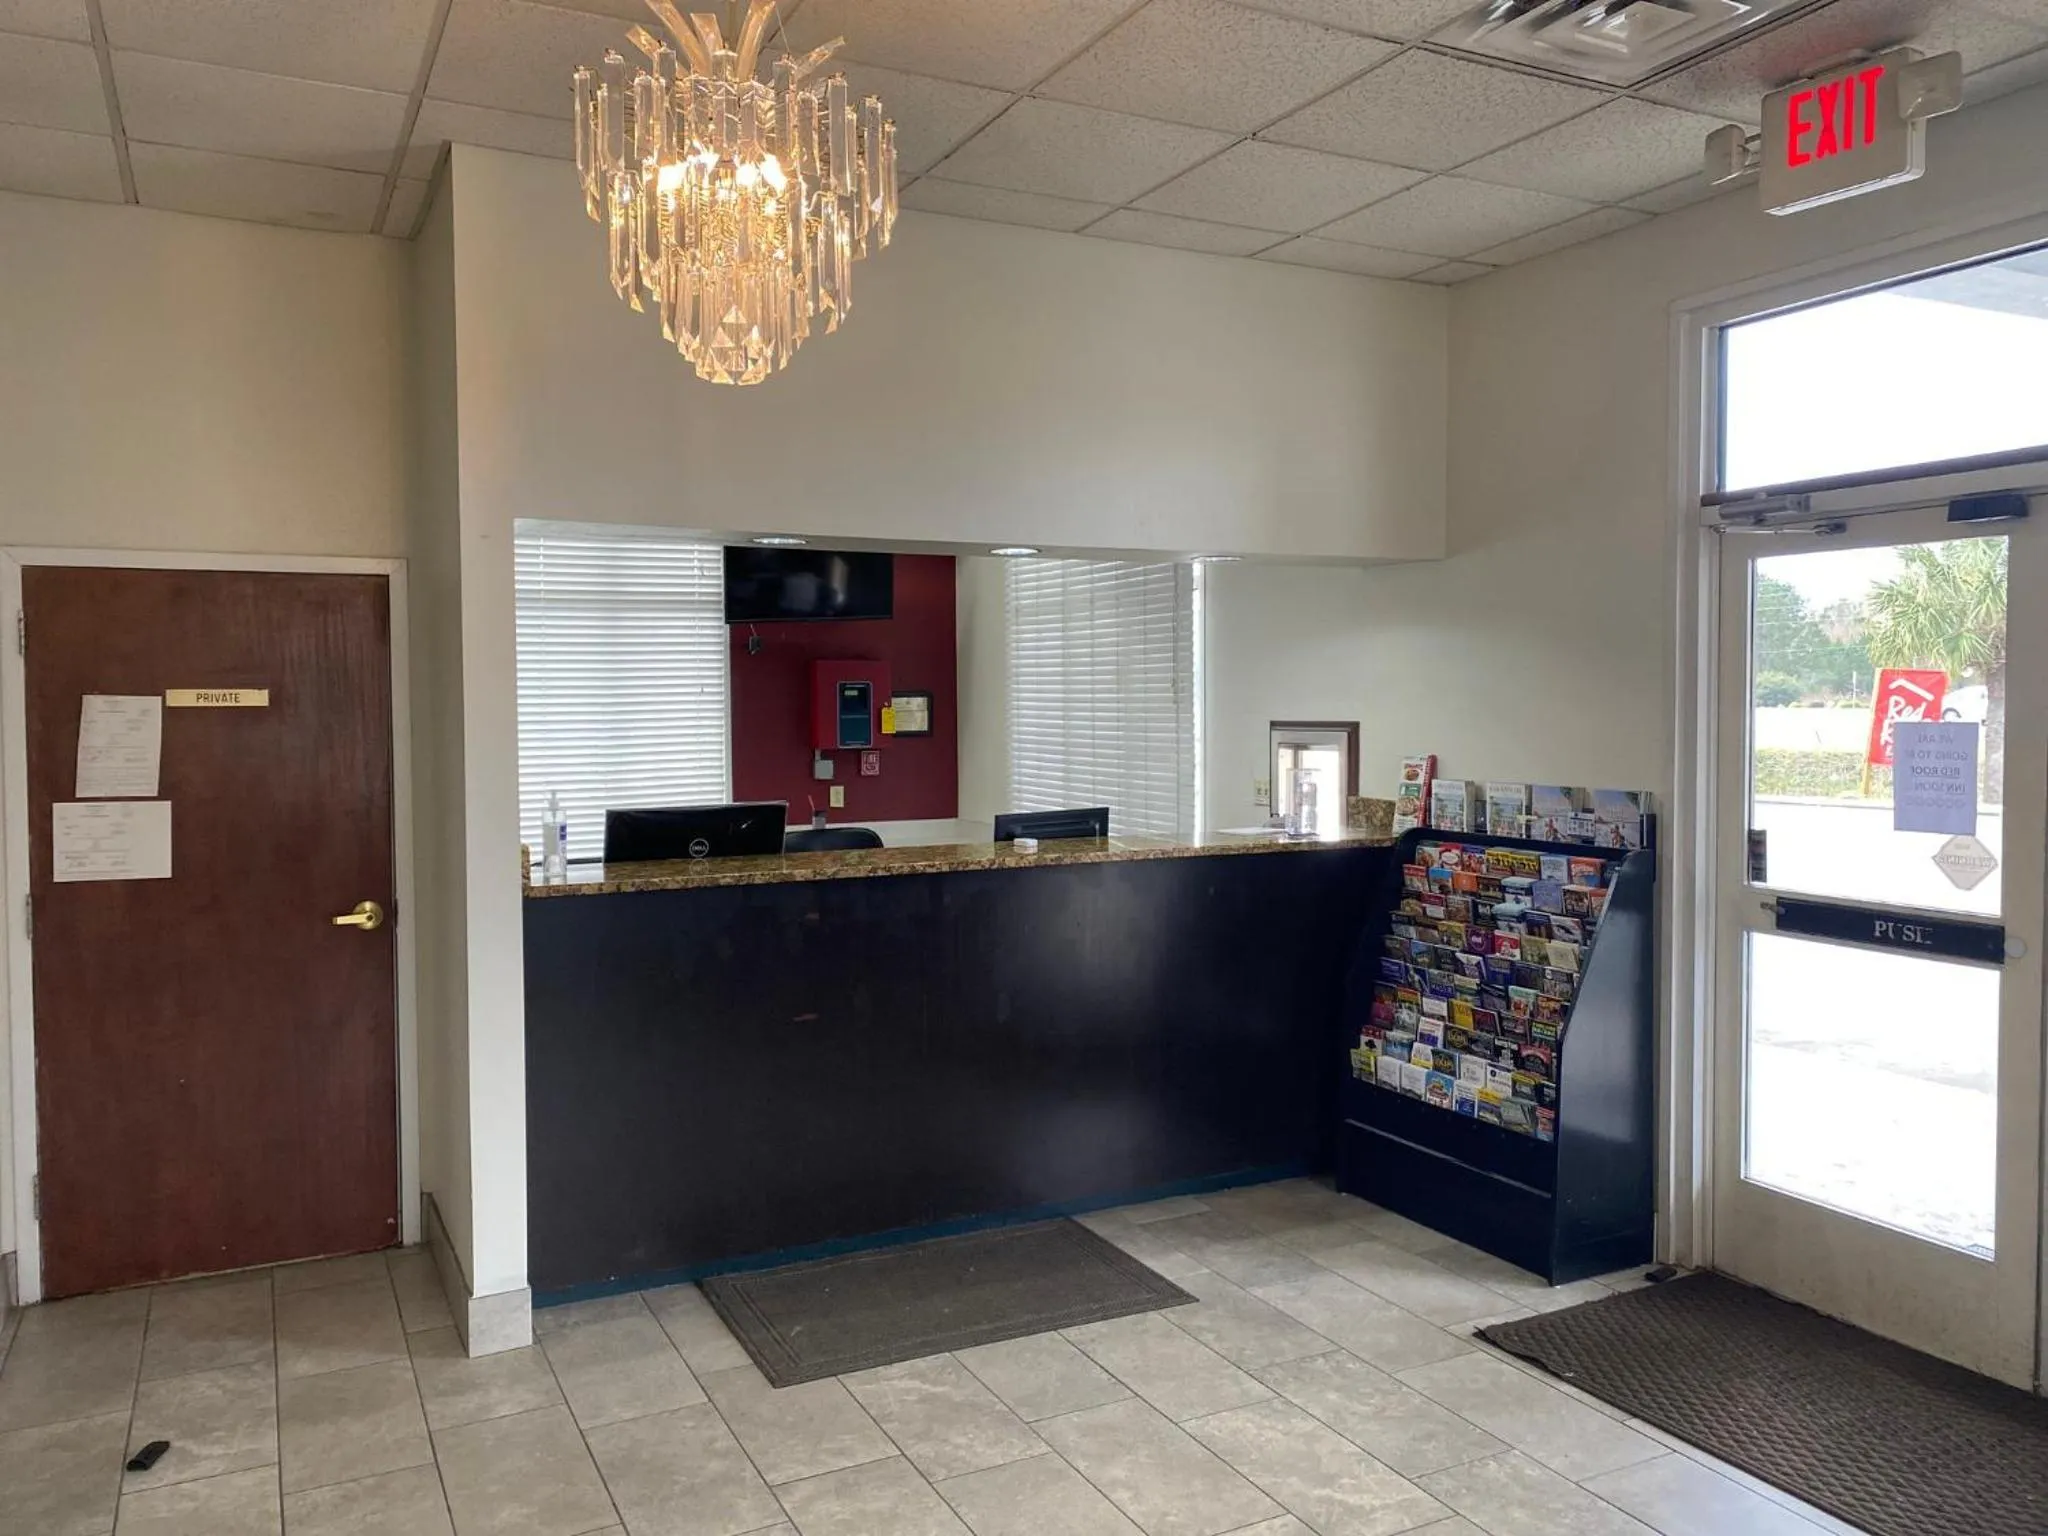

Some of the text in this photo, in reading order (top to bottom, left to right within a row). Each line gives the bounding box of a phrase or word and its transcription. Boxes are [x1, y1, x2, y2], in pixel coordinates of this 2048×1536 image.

[1787, 64, 1885, 168] EXIT
[196, 692, 241, 704] PRIVATE
[1887, 694, 1928, 722] Red
